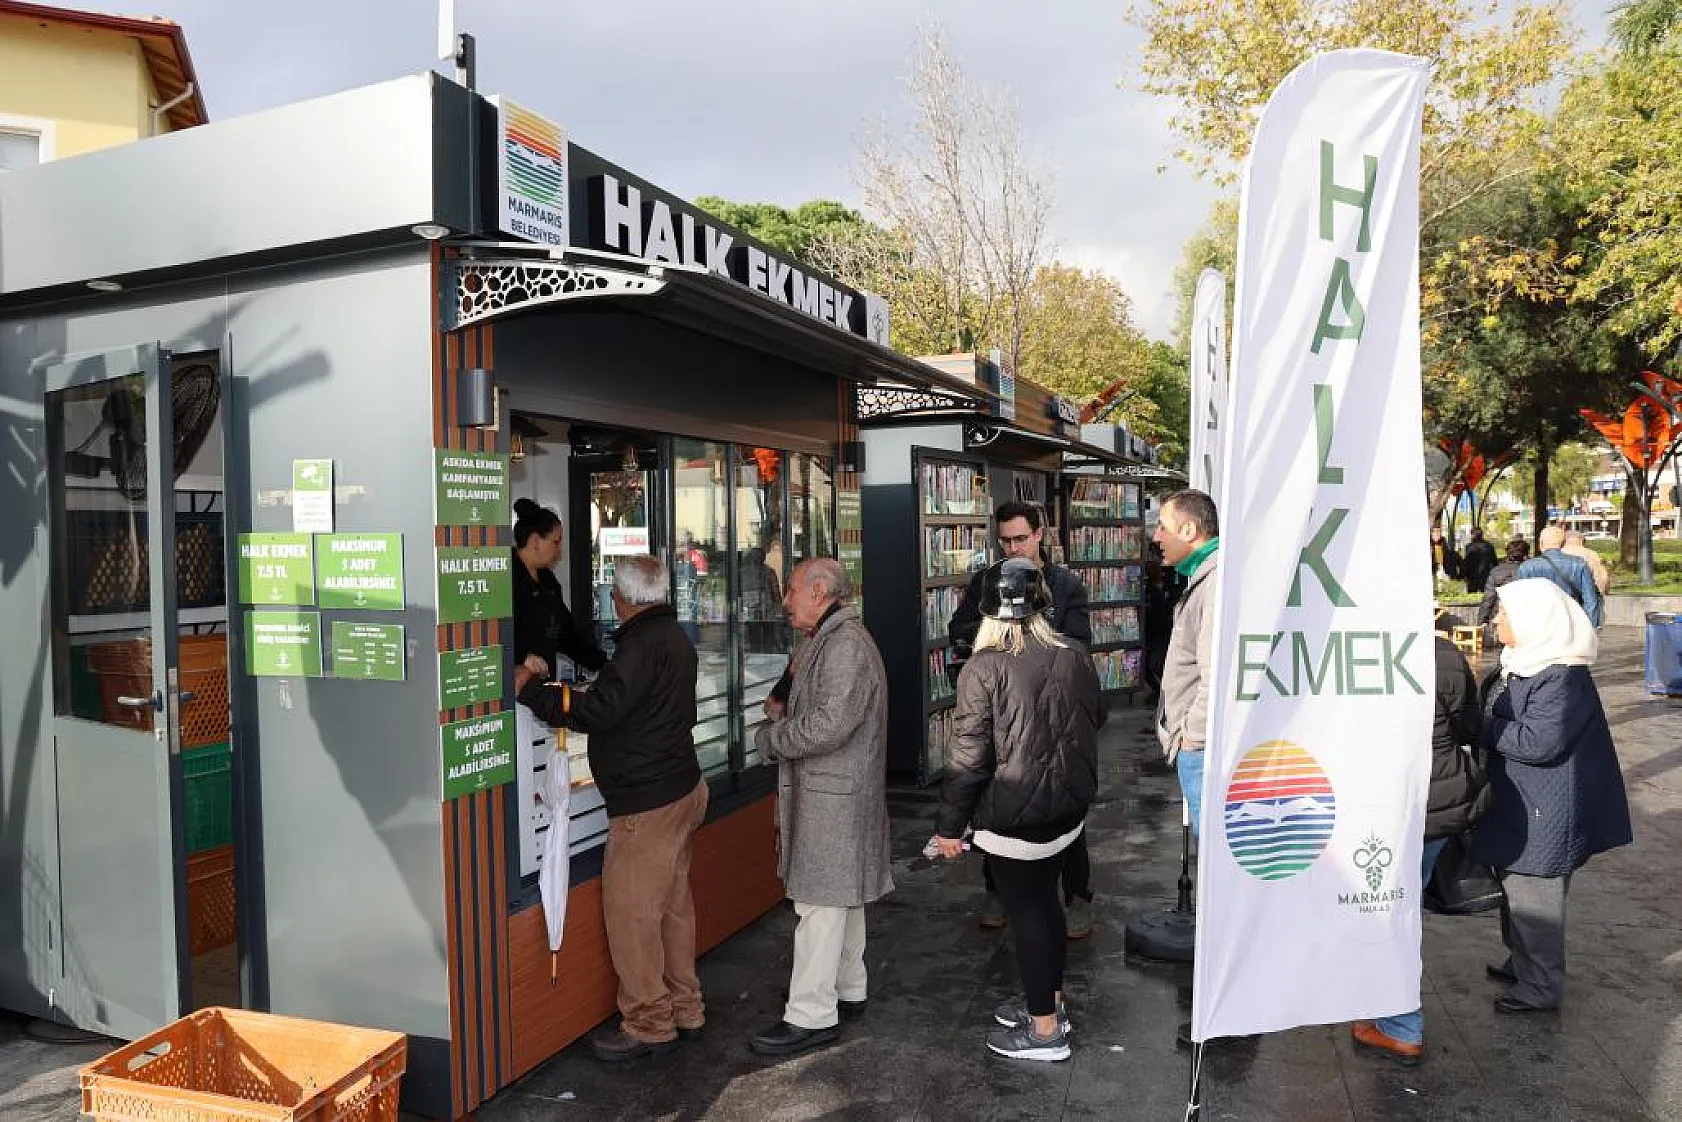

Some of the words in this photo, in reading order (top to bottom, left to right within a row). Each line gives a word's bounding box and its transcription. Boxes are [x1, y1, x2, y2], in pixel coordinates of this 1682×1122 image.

[603, 174, 734, 278] HALK
[748, 246, 854, 331] EKMEK
[475, 459, 503, 470] EKMEK
[241, 543, 268, 558] HALK
[270, 543, 308, 558] EKMEK
[350, 558, 377, 571] ADET
[440, 558, 470, 575] HALK
[472, 557, 508, 572] EKMEK
[476, 578, 490, 593] TL
[1235, 630, 1426, 701] EKMEK
[472, 738, 496, 755] ADET
